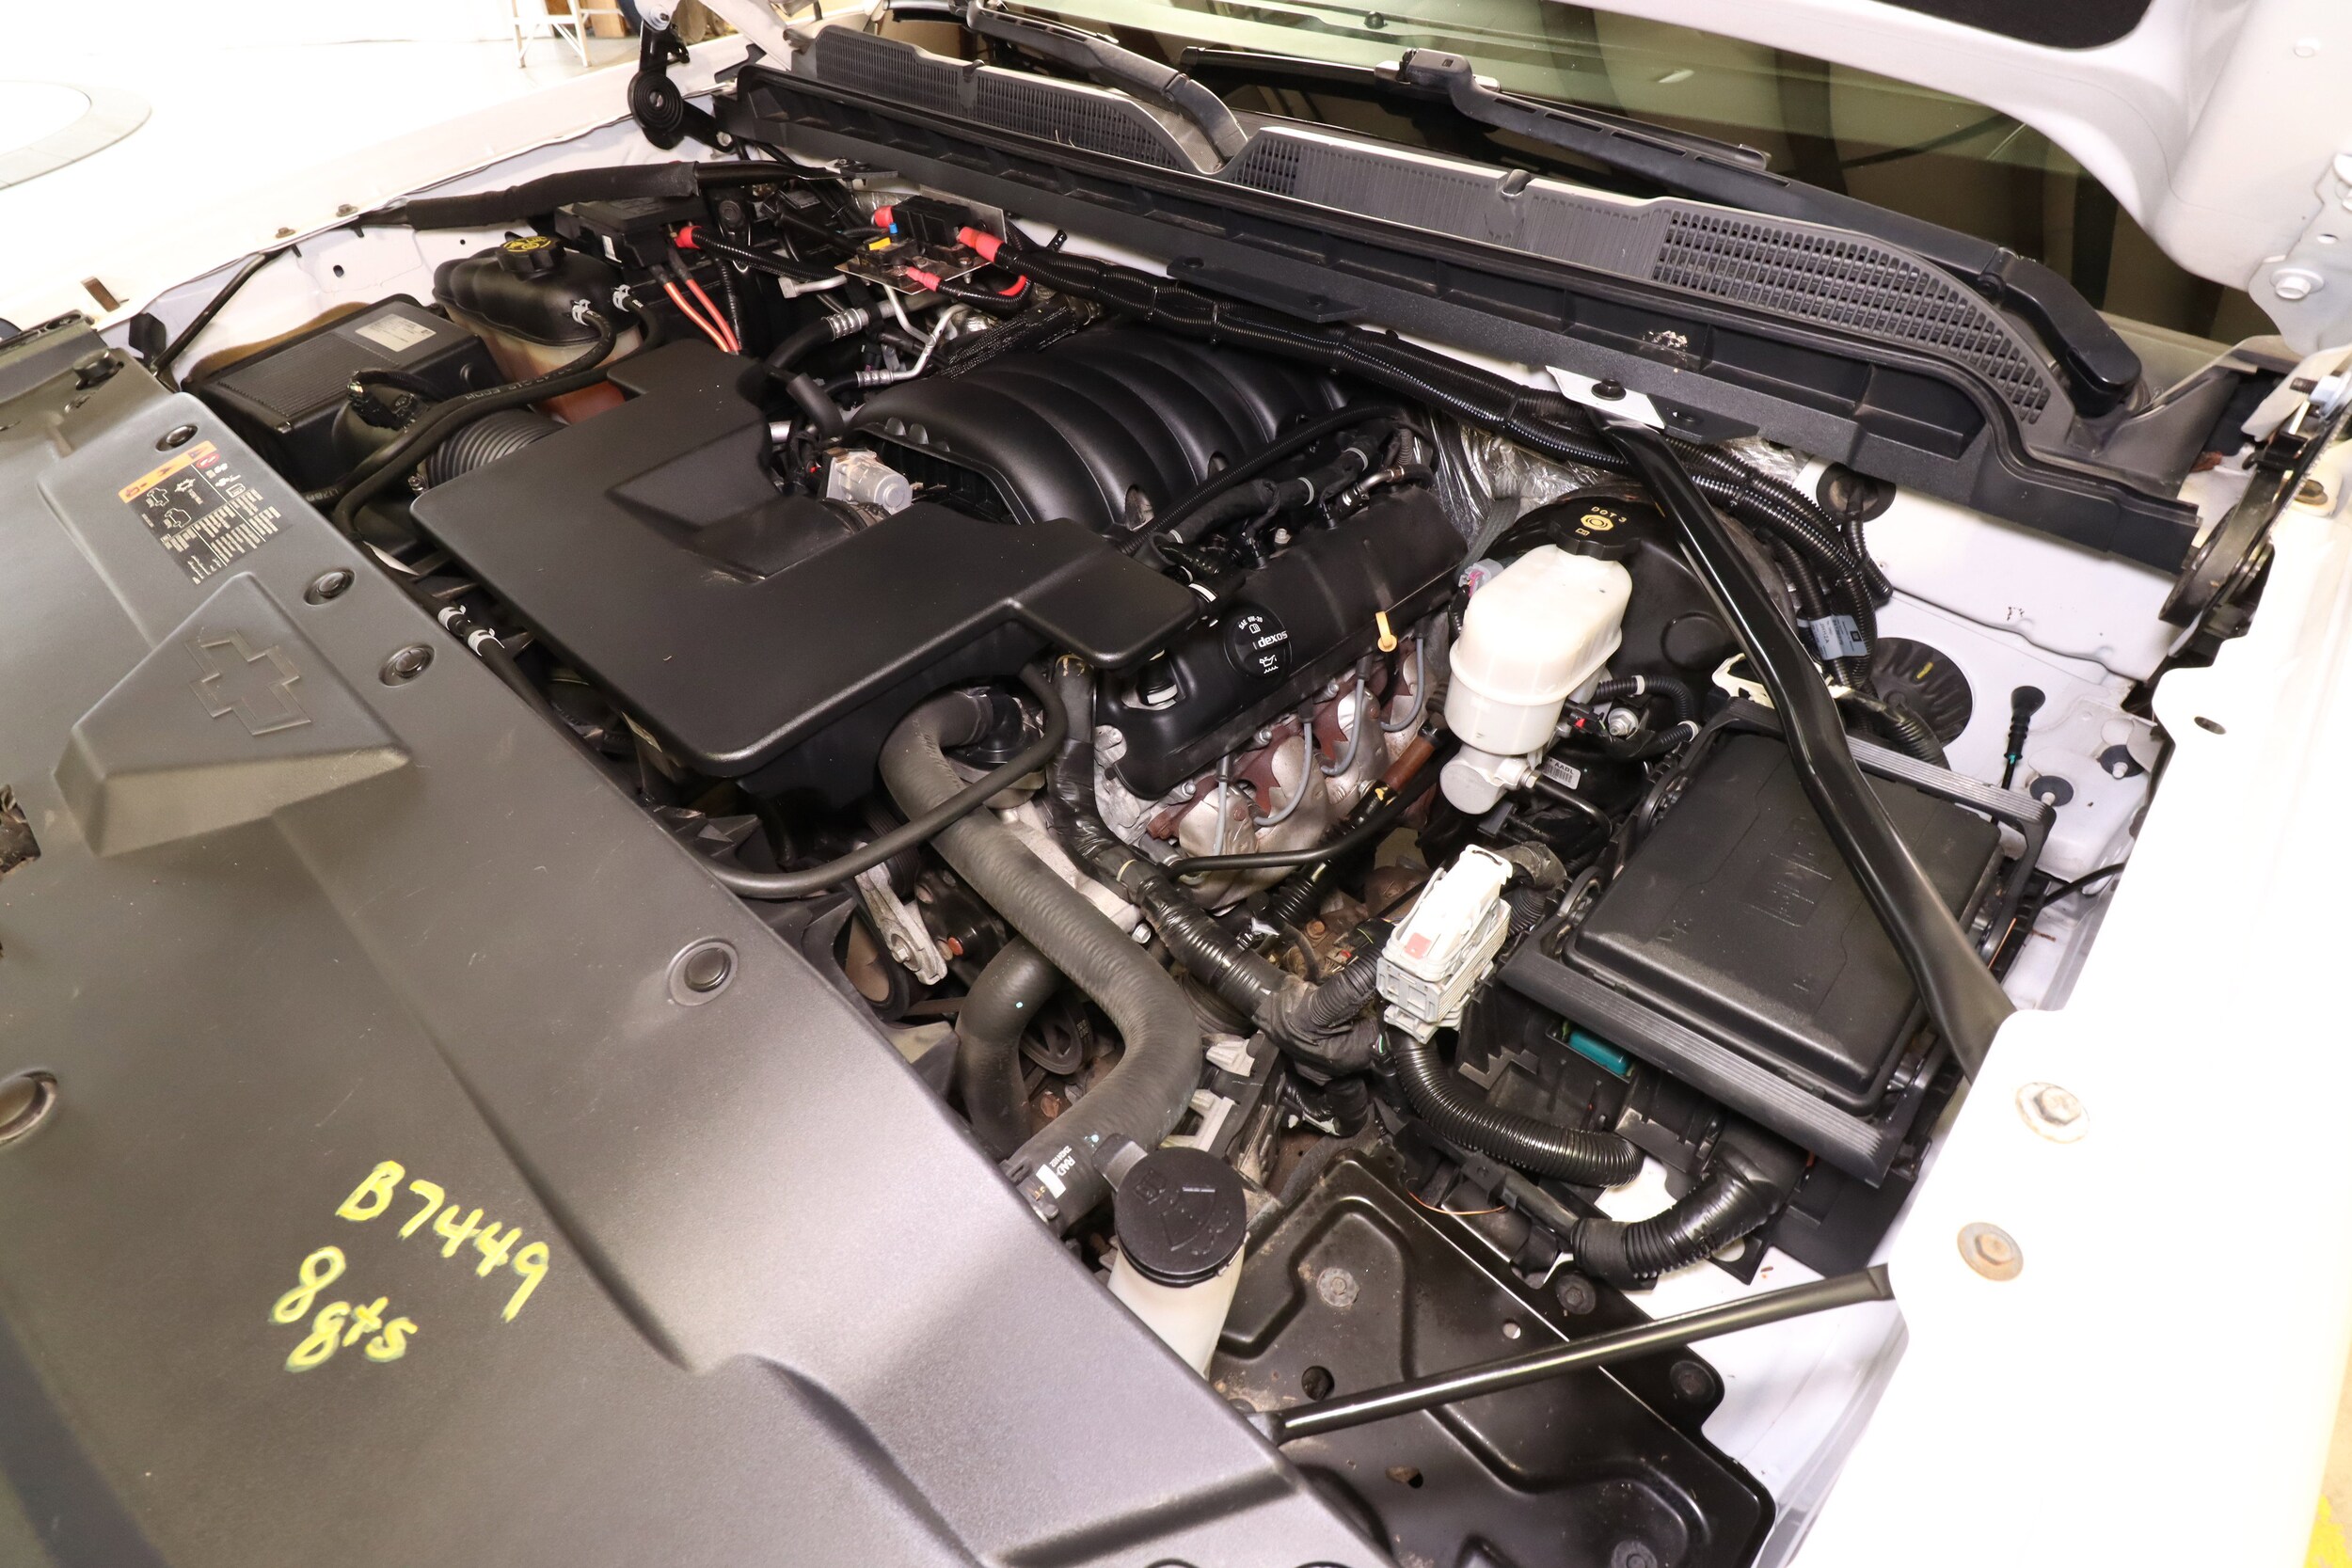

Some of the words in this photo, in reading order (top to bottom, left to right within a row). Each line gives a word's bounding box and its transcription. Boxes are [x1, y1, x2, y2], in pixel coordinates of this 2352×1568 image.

[1591, 506, 1617, 518] DOT
[1238, 619, 1248, 630] SAE
[1258, 630, 1288, 648] dexos
[1554, 762, 1574, 775] AADL
[1056, 1155, 1076, 1177] RAD
